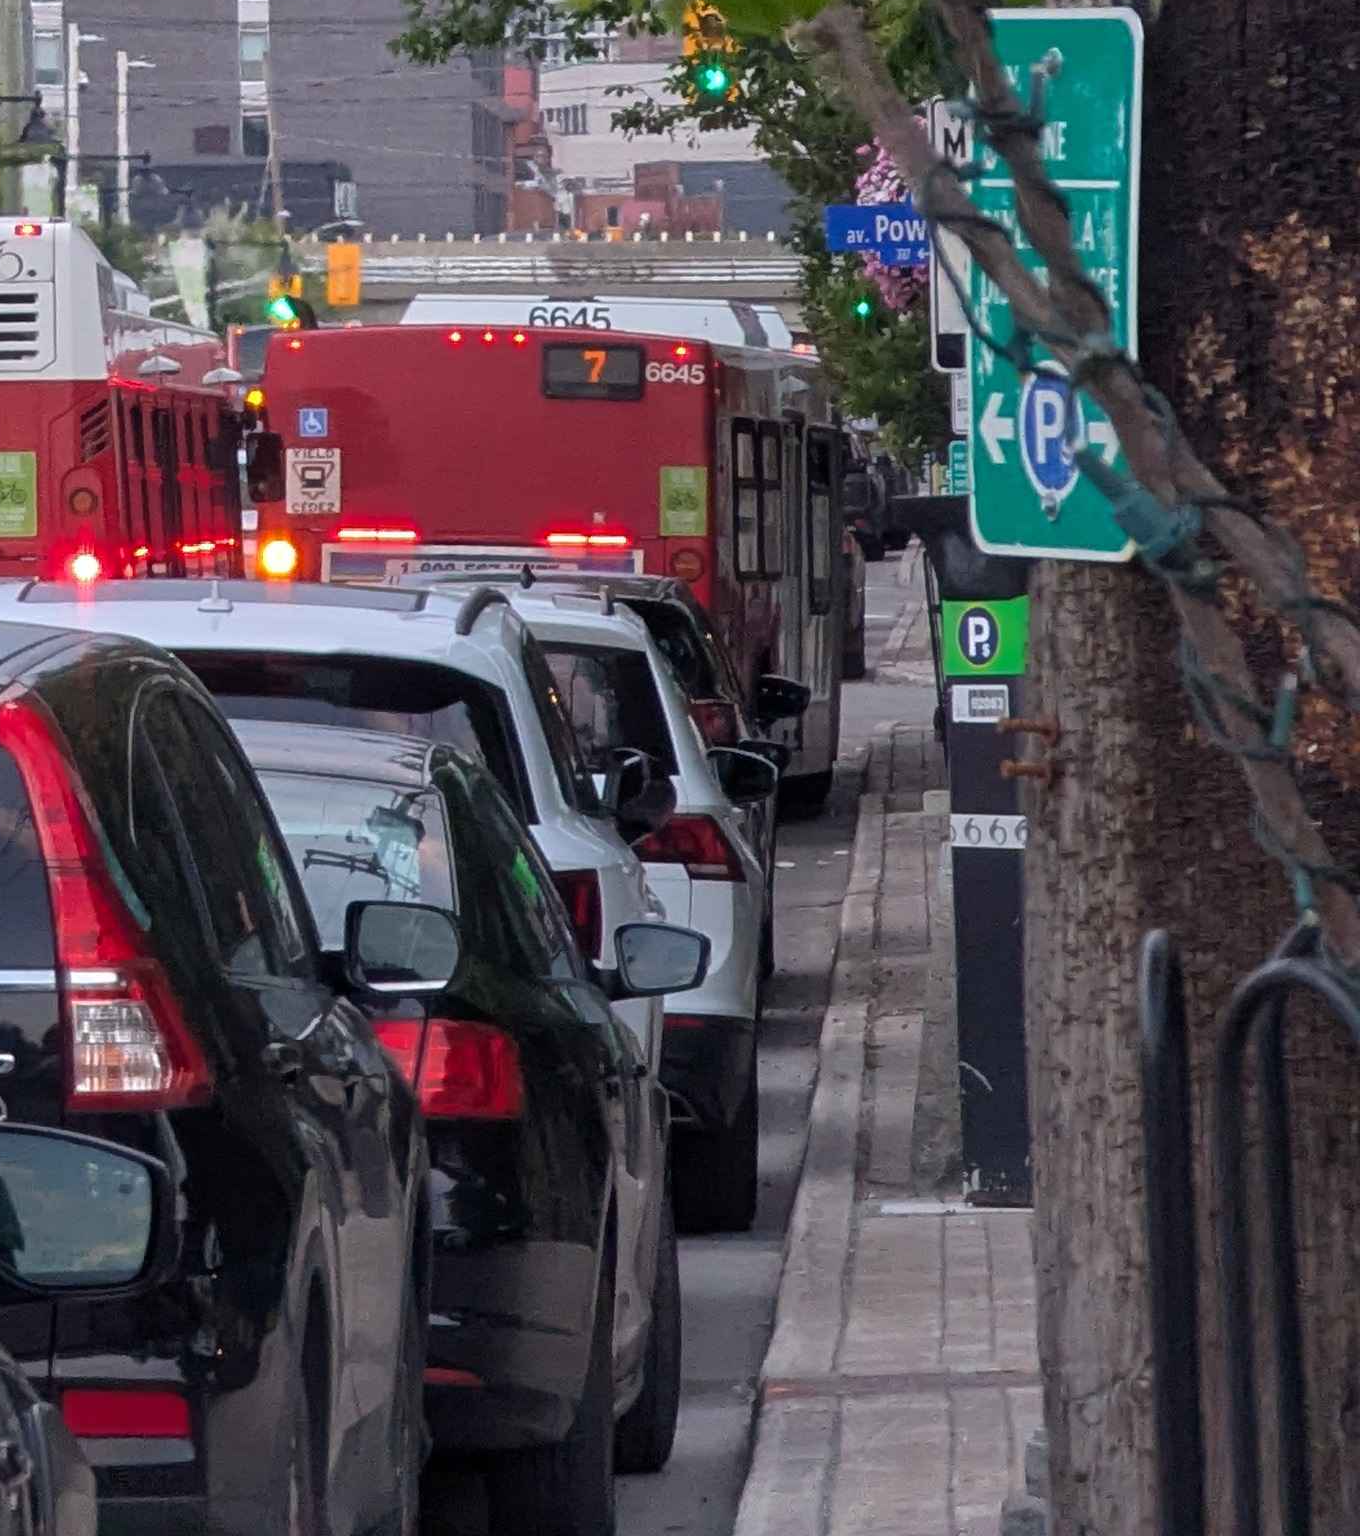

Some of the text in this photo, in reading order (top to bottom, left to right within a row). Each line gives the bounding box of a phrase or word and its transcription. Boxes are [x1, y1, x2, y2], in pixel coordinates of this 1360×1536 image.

[846, 230, 870, 243] av.
[529, 306, 612, 329] 6645
[583, 350, 607, 382] 7
[645, 362, 705, 385] 6645
[294, 447, 335, 458] YIELD
